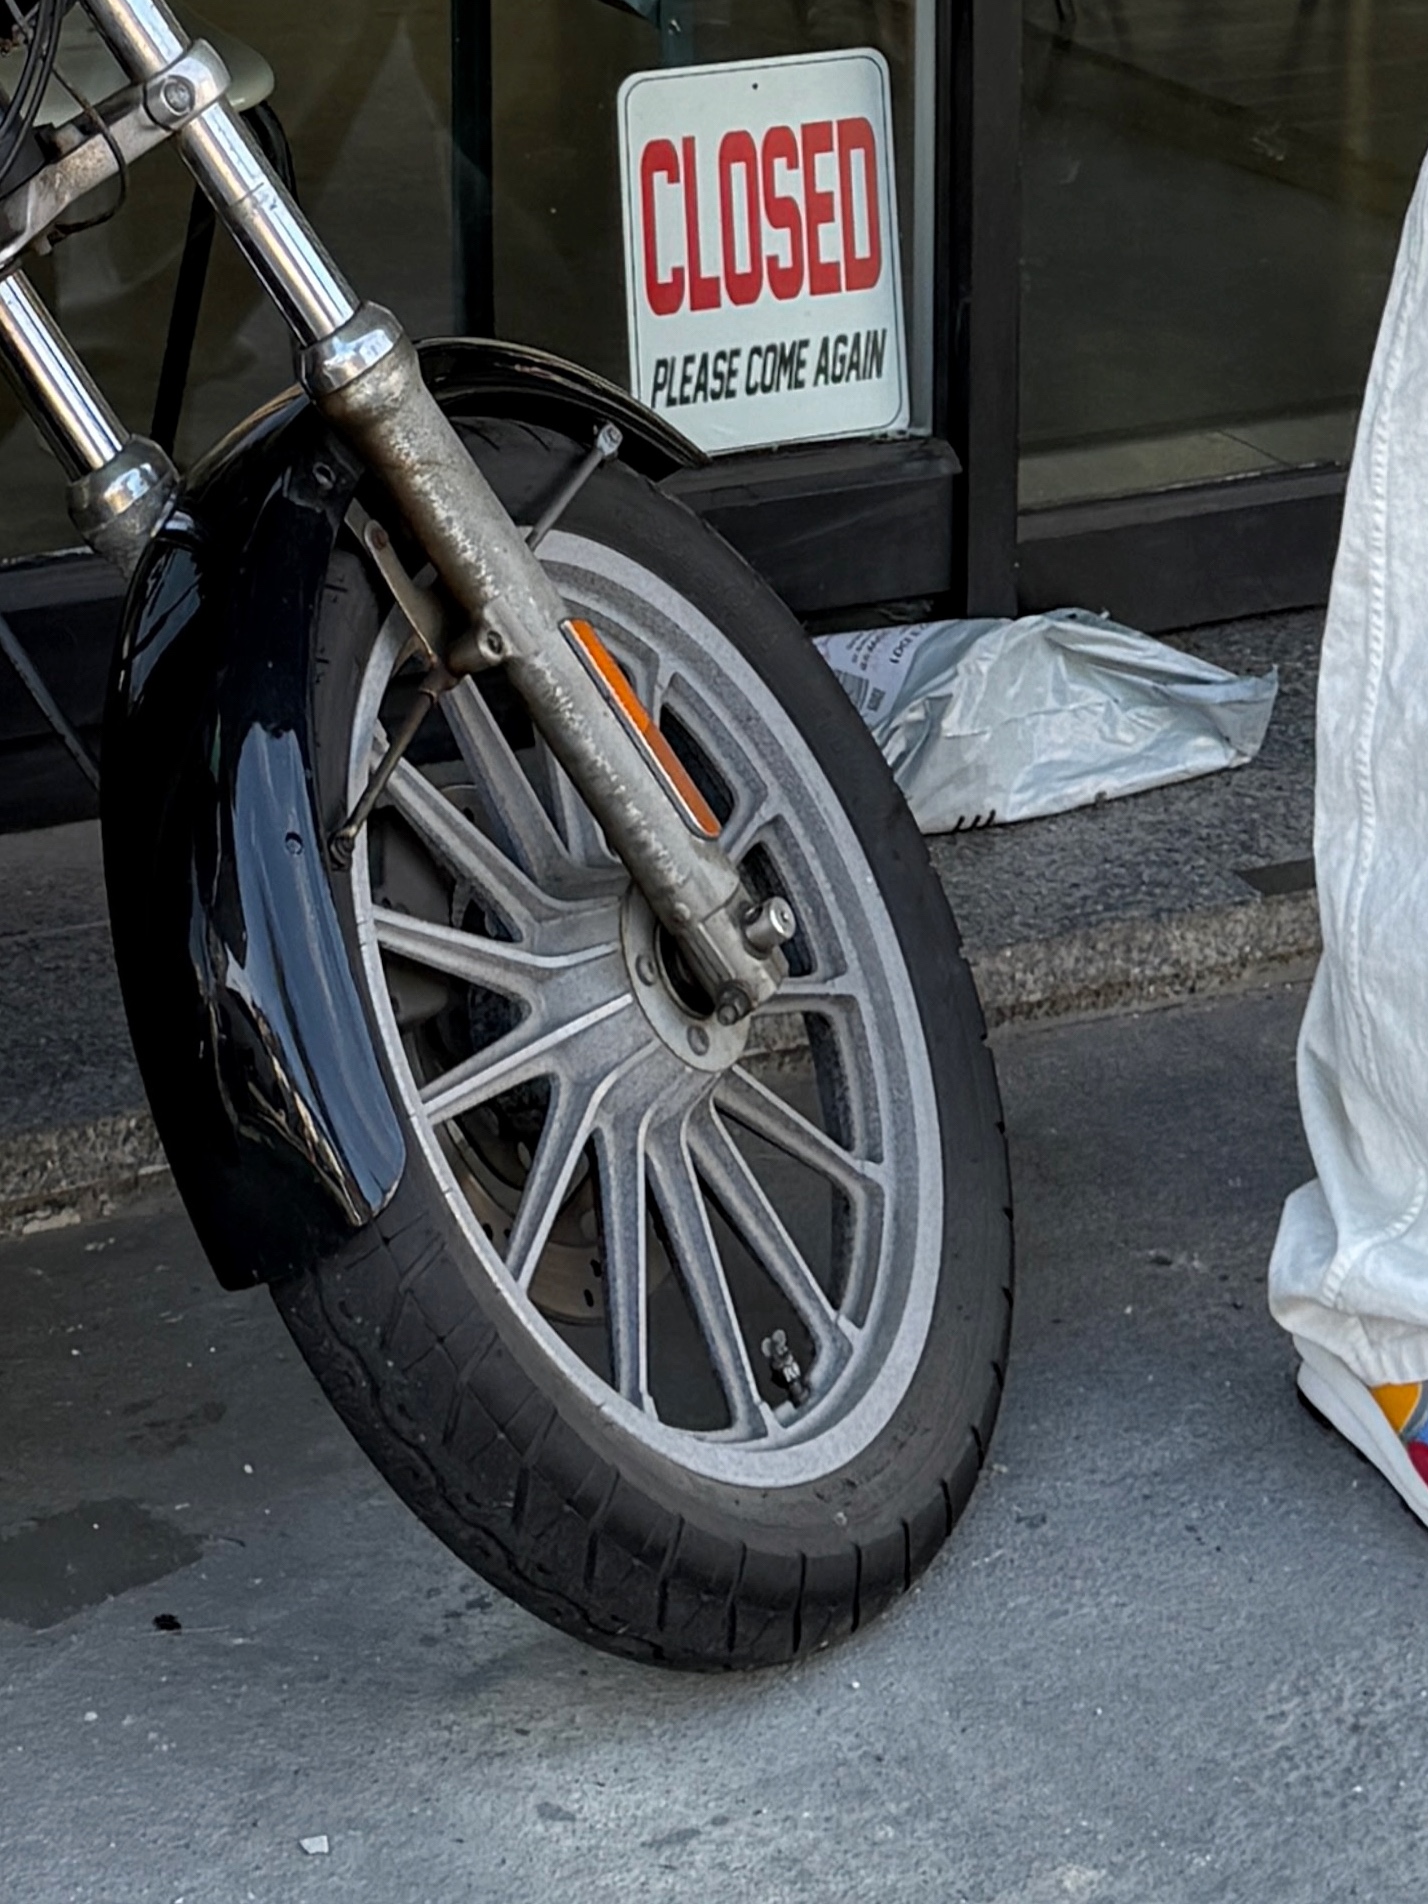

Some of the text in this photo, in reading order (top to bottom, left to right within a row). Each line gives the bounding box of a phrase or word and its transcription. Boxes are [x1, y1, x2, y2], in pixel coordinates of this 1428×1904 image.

[639, 116, 883, 317] CLOSED
[650, 328, 888, 409] PLEASE COME AGAIN
